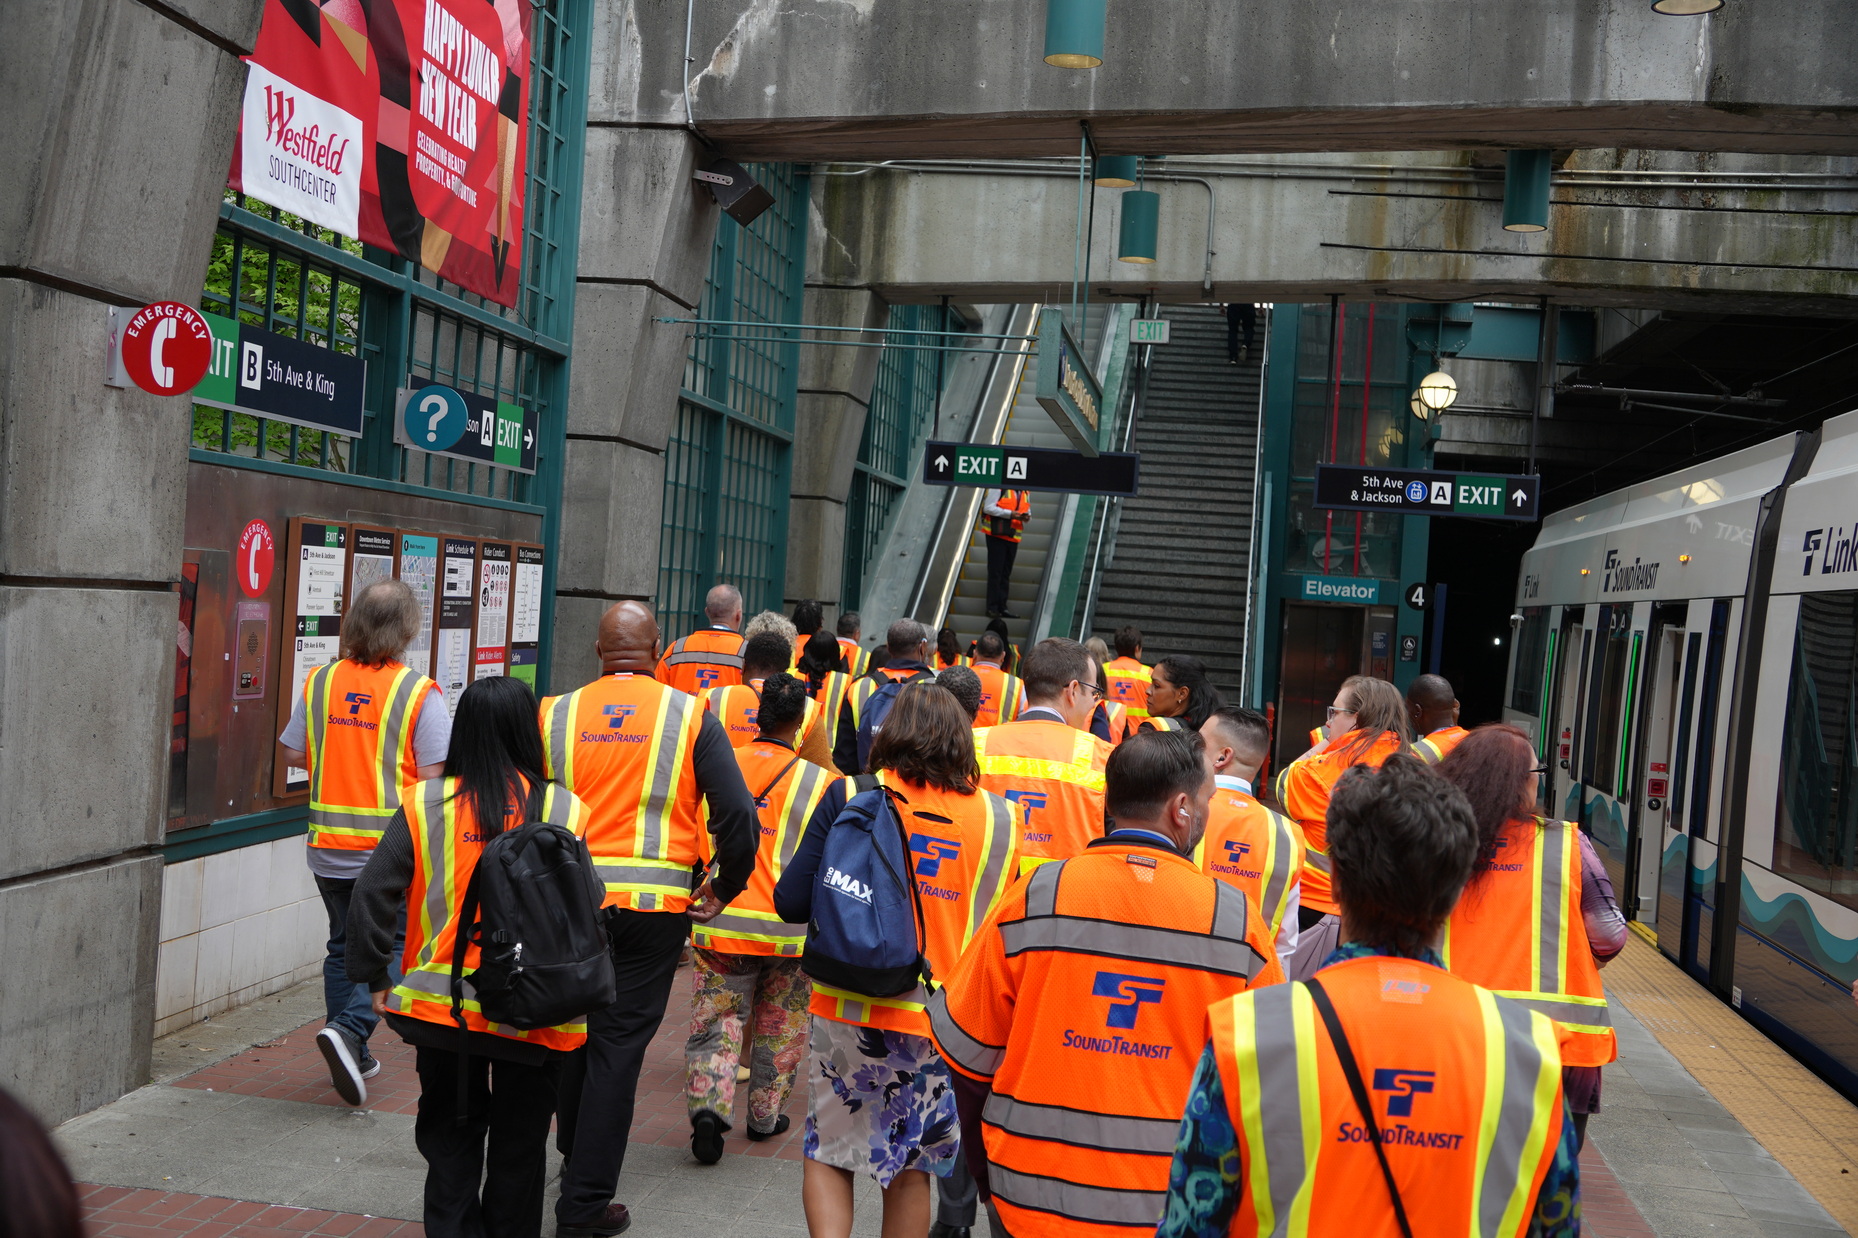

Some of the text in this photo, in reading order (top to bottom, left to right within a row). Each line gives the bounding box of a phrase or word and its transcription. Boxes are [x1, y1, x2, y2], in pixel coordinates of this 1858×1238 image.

[423, 0, 500, 107] HAPPY LUNAR
[419, 57, 477, 152] NEW YEAR
[263, 84, 350, 176] Westfield
[268, 154, 337, 205] SOUTHCENTER
[127, 304, 207, 340] EMERGENCY
[1137, 321, 1165, 341] EXIT
[247, 349, 258, 382] B
[266, 360, 283, 383] 5th
[285, 365, 303, 388] Ave
[305, 370, 313, 390] &
[315, 373, 335, 402] King
[484, 416, 491, 441] A
[497, 418, 521, 450] EXIT
[957, 455, 1023, 476] EXIT A
[1362, 476, 1404, 489] 5th Ave
[1350, 490, 1403, 504] & Jackson
[1434, 485, 1502, 506] A EXIT
[240, 523, 273, 550] EMERGENCY
[326, 531, 337, 543] EXIT
[445, 543, 469, 555] Link Schedule
[484, 547, 506, 557] Rider Conduct
[525, 550, 541, 559] Connections
[1821, 522, 1858, 575] Link
[1305, 580, 1376, 599] Elevator
[1411, 586, 1425, 607] 4
[306, 621, 318, 632] EXIT
[477, 652, 486, 661] Link
[493, 651, 503, 660] Alerts
[823, 866, 835, 883] Eno
[830, 869, 873, 904] MAX
[917, 880, 962, 902] TRANSIT
